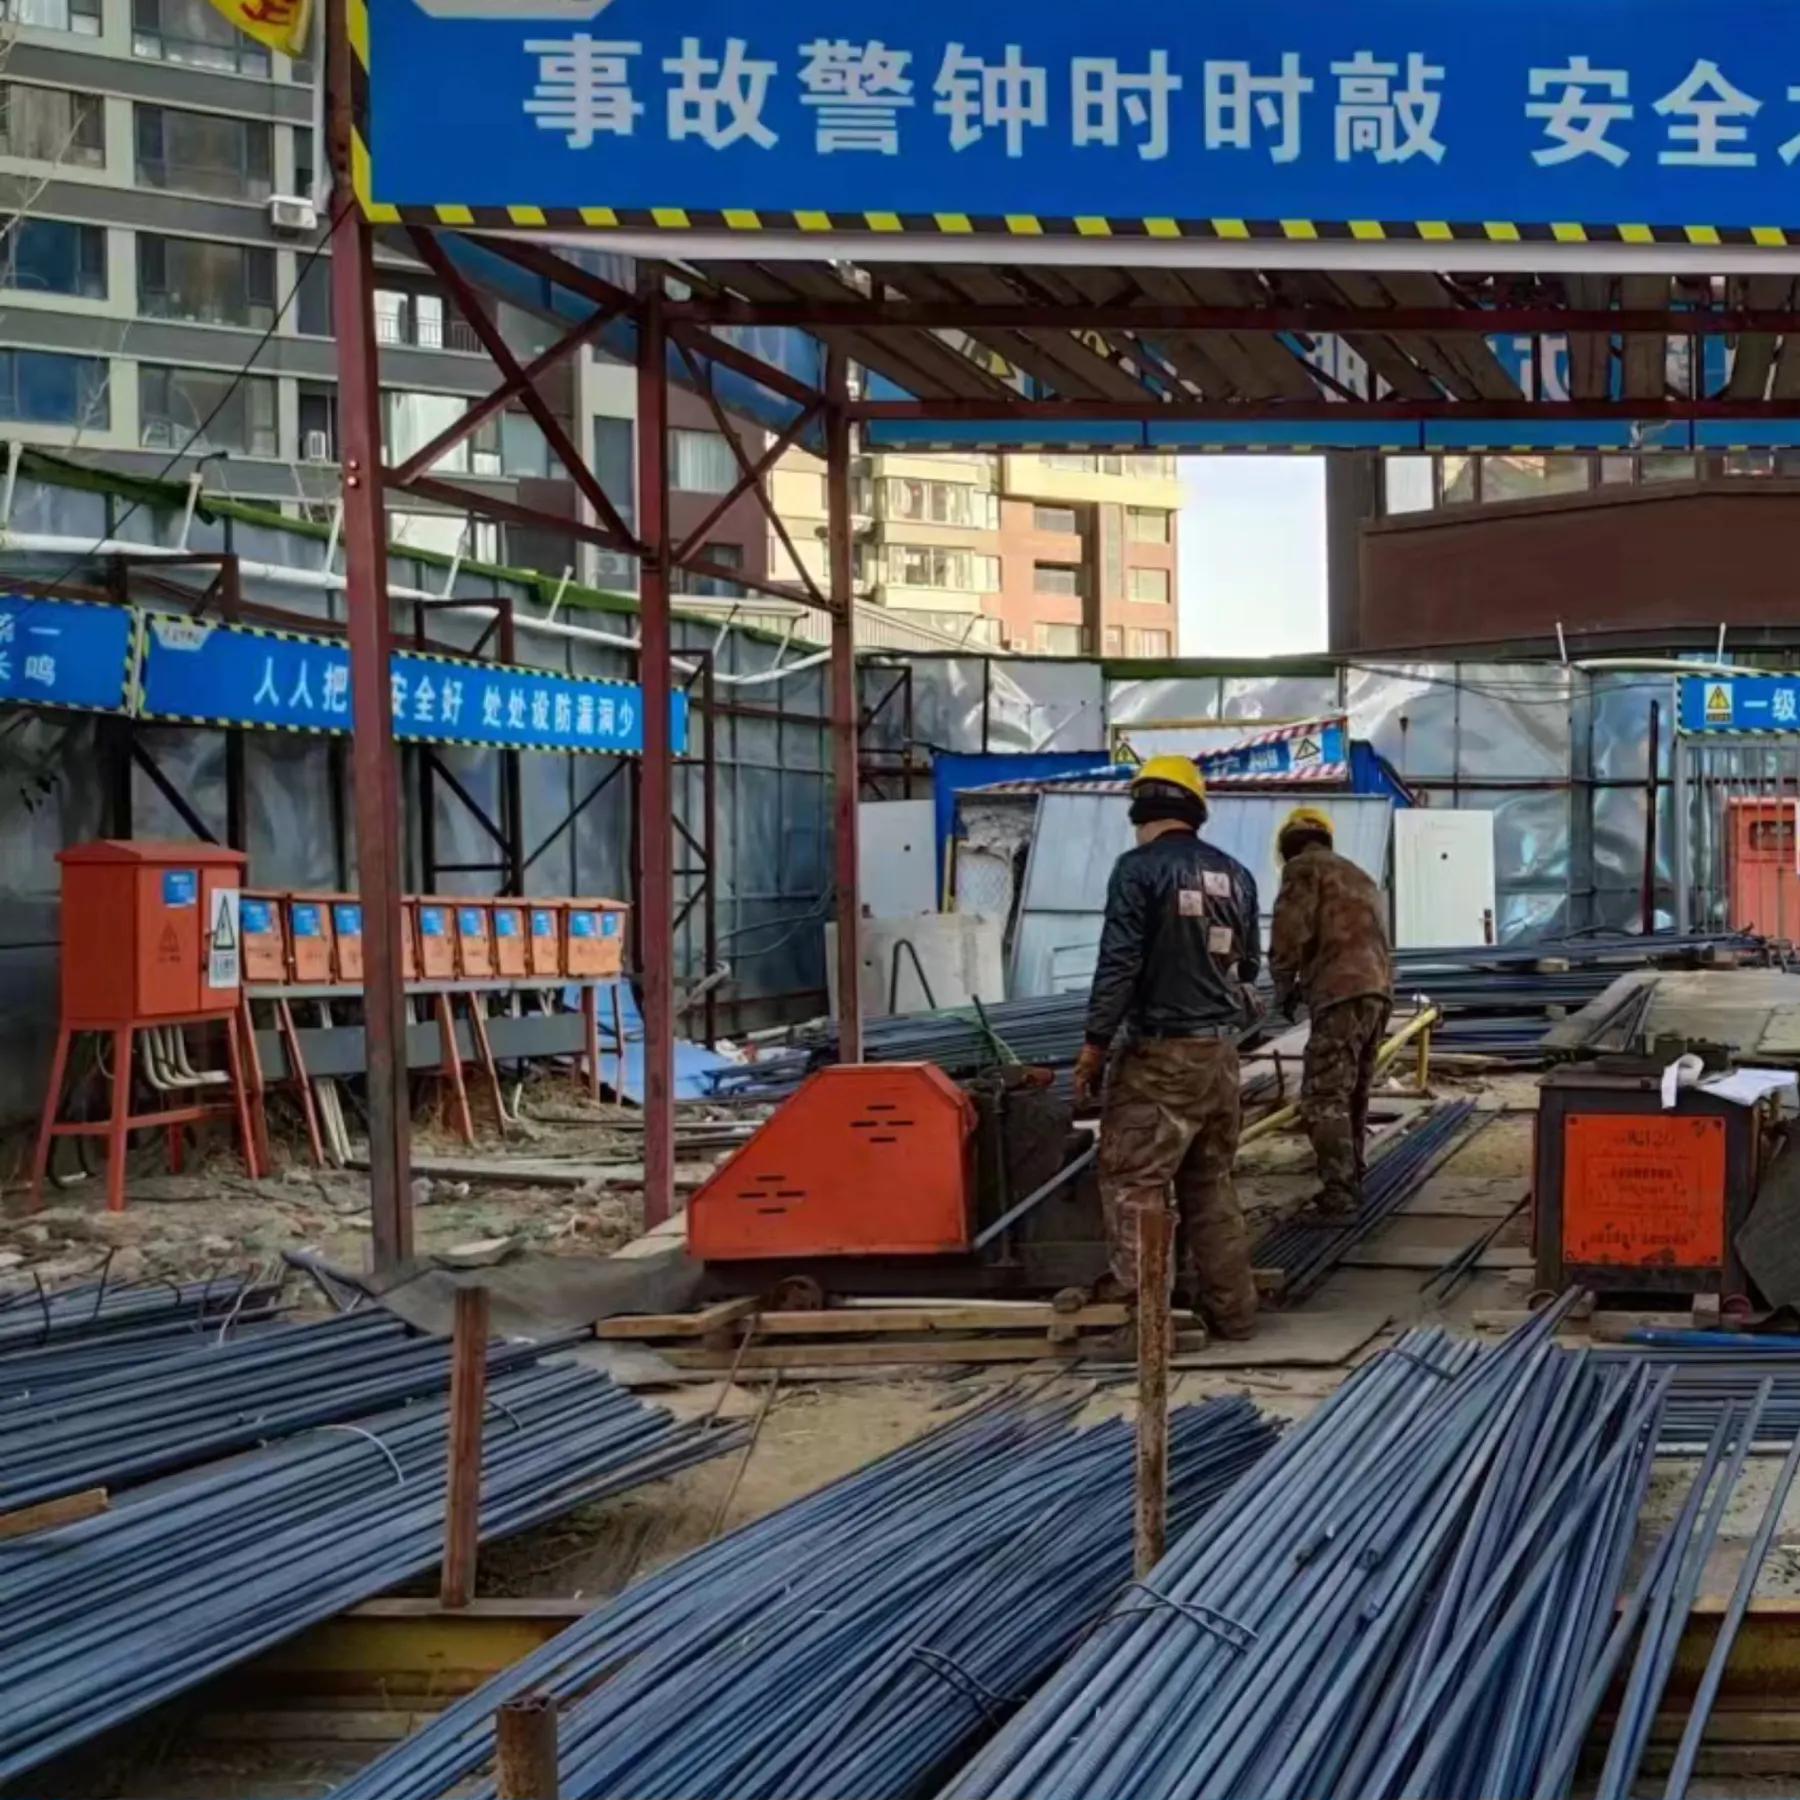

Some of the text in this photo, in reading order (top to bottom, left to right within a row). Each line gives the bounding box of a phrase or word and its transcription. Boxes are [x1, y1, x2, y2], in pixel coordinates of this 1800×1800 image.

[523, 33, 1446, 166] 事故警钟时时敲
[253, 656, 463, 726] 人人把安全好
